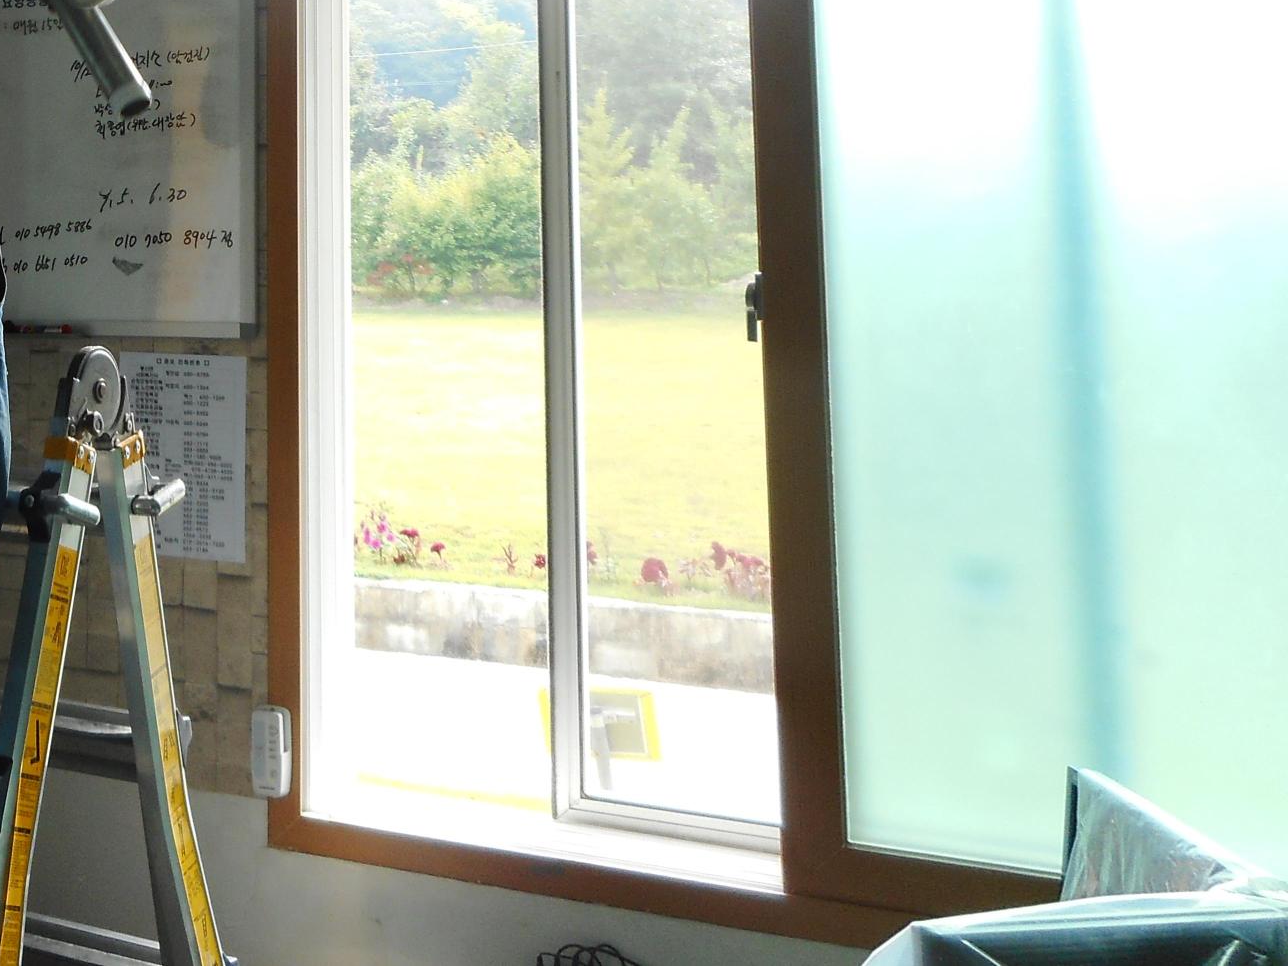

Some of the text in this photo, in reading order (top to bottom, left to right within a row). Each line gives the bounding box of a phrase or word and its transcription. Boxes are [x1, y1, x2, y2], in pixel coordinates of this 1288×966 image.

[33, 223, 61, 238] 5498
[114, 233, 138, 249] 010
[183, 229, 217, 249] 8904
